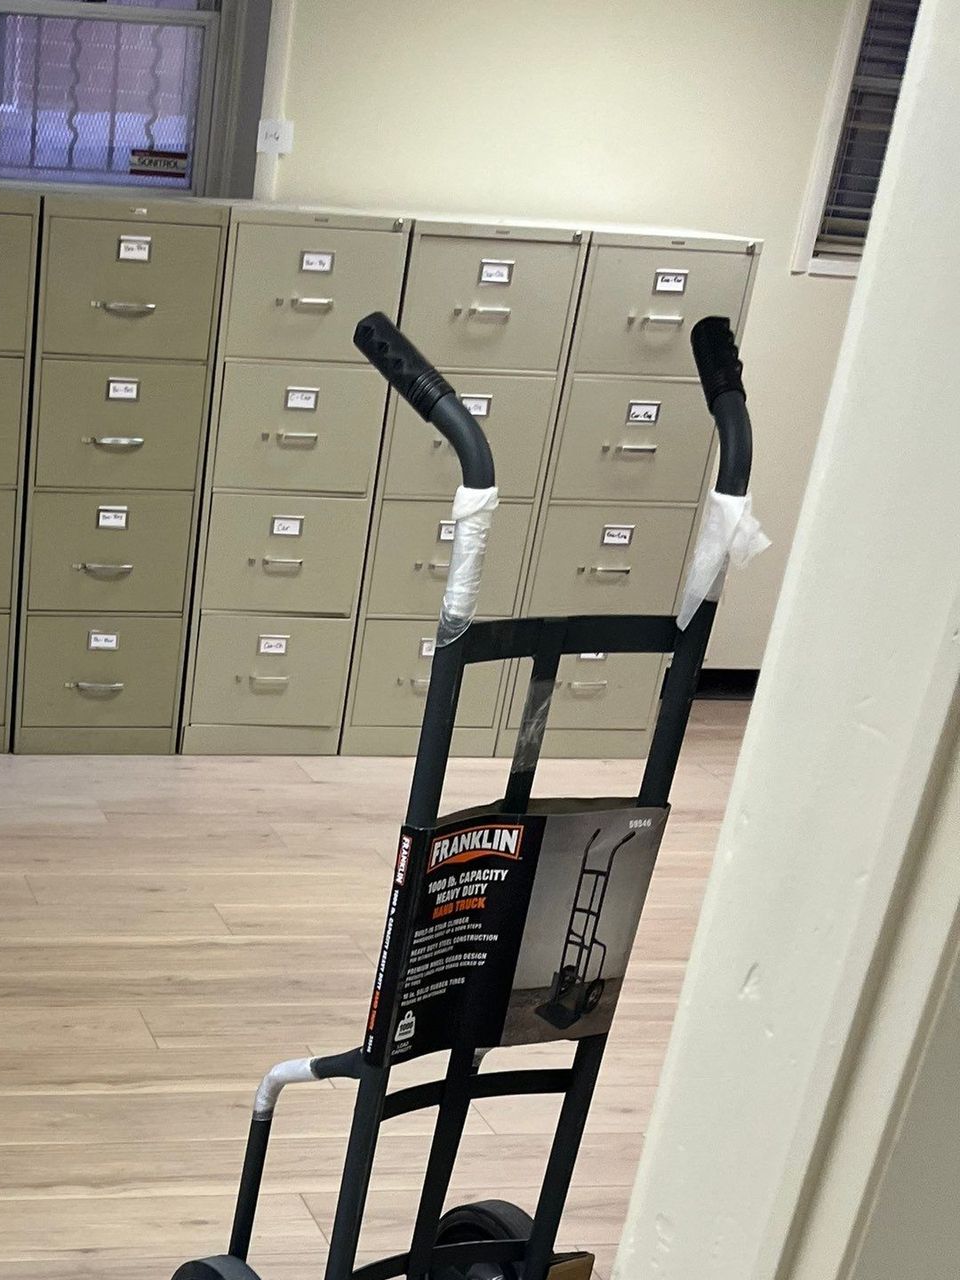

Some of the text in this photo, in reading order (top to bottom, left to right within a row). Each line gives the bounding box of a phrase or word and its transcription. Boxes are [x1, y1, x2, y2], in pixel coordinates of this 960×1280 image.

[137, 157, 179, 169] SONITROL
[430, 829, 520, 867] FRANKLIN
[395, 836, 410, 884] FRANKLIN
[428, 869, 509, 894] 1000 lb. CAPACITY
[436, 883, 488, 905] HEAVY DUTY
[432, 896, 486, 919] HAND TRUCK
[452, 934, 499, 945] CONSTRUCTION
[463, 952, 488, 960] DESIGN
[449, 977, 465, 986] TIRES
